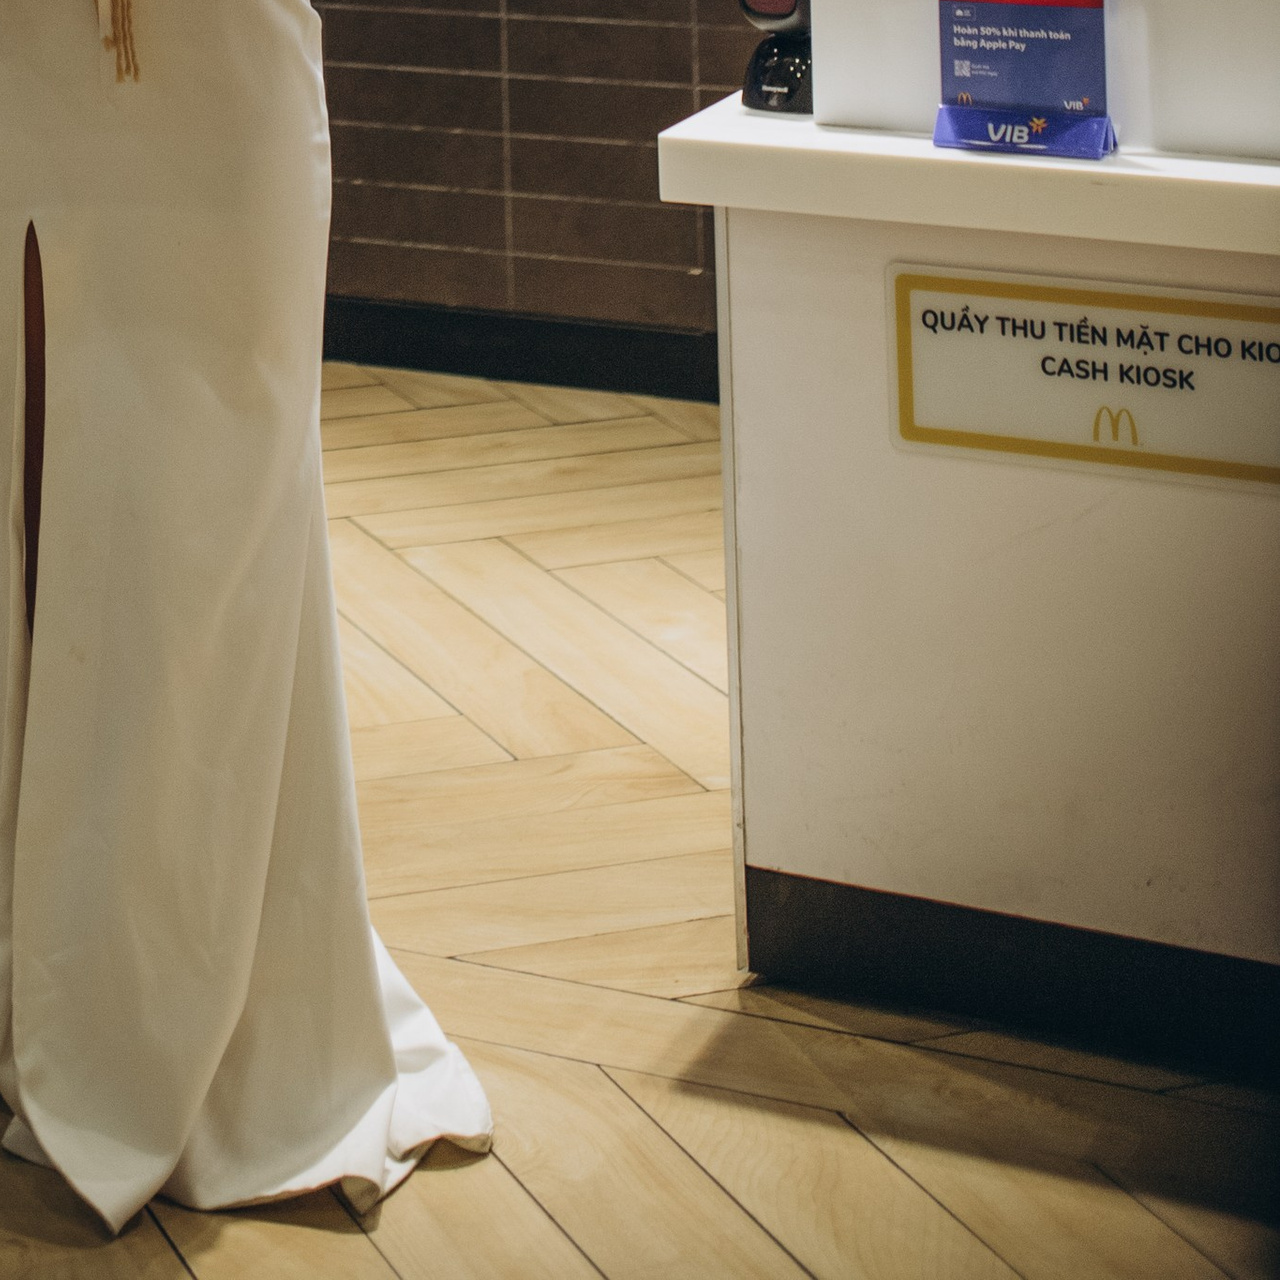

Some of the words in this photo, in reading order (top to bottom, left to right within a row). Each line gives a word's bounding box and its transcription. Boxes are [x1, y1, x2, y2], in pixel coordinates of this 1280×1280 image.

[953, 25, 979, 35] Hoàn
[980, 26, 1001, 37] 50%
[1002, 27, 1018, 38] khi
[1019, 29, 1047, 39] thanh
[1049, 30, 1071, 41] toán
[980, 39, 1007, 51] Apple
[1009, 41, 1026, 52] Pay
[1063, 100, 1084, 111] VIB
[987, 122, 1030, 144] VIB
[995, 315, 1046, 340] THU
[1053, 316, 1107, 346] TIỀN
[1116, 325, 1170, 356] MẶT
[1177, 334, 1232, 359] CHO
[1040, 355, 1109, 382] CASH
[1119, 362, 1196, 391] KIOSK
